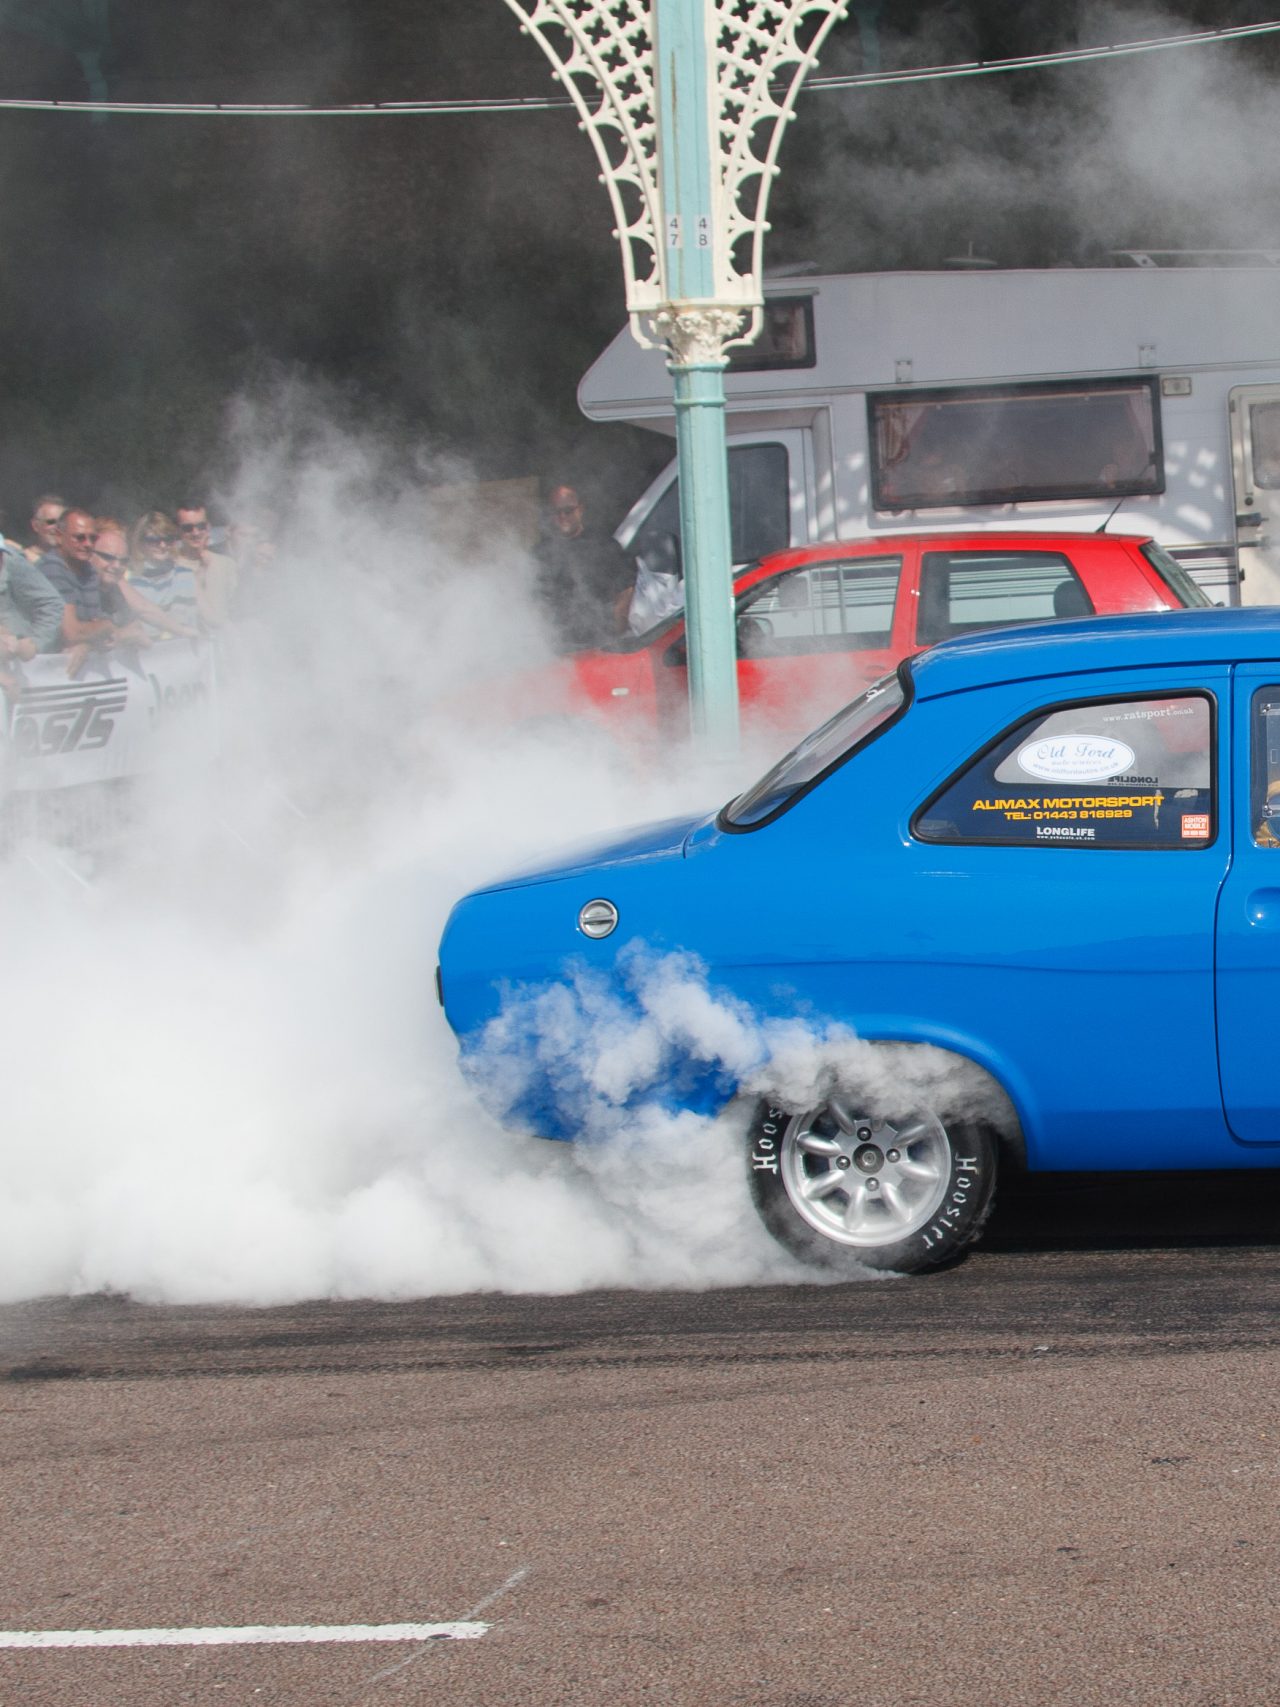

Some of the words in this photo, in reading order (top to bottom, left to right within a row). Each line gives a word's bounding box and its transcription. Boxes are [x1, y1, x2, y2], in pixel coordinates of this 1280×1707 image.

[1074, 743, 1116, 759] Ford
[973, 798, 1040, 811] ALIMAX
[1043, 796, 1165, 809] MOTORSPORT
[1004, 811, 1031, 820] TEL:
[1033, 810, 1078, 819] 01443
[1036, 826, 1095, 837] LONGLIFE
